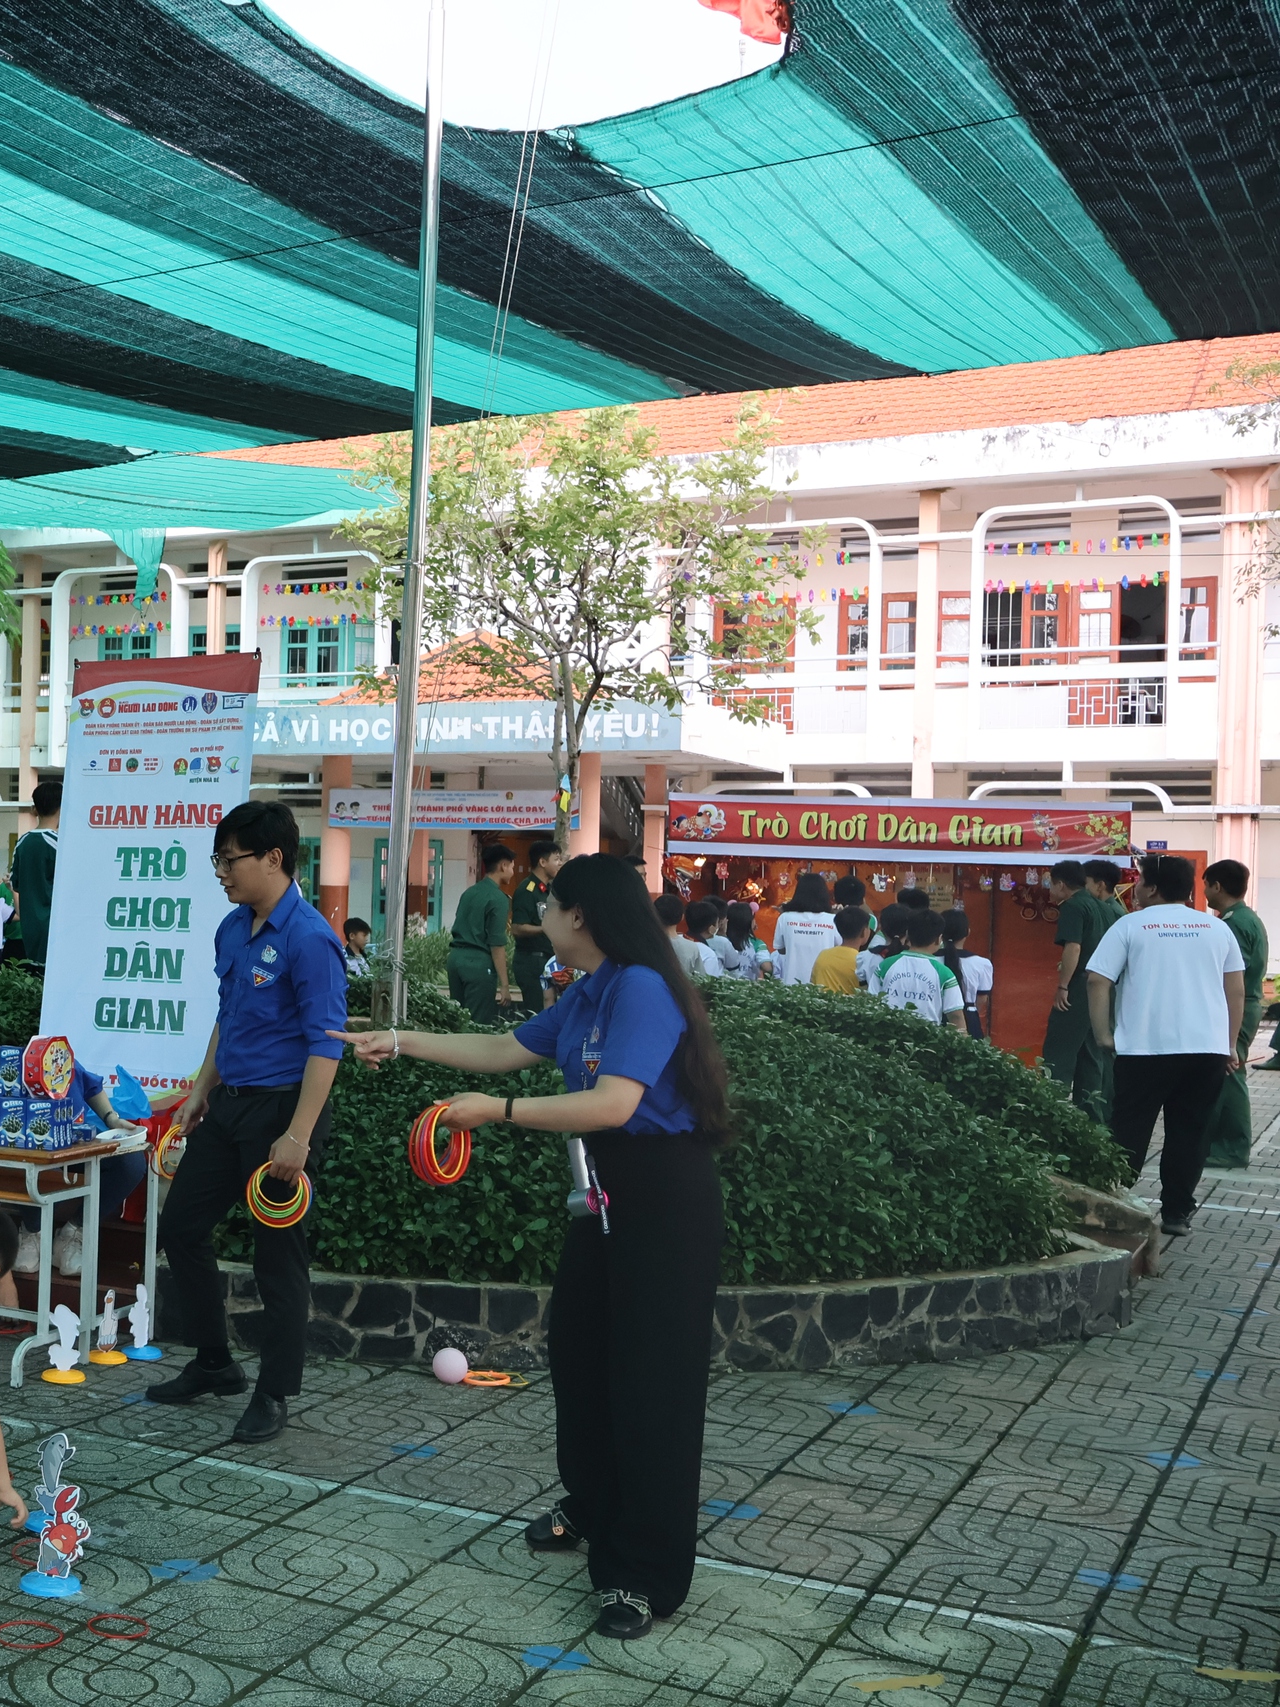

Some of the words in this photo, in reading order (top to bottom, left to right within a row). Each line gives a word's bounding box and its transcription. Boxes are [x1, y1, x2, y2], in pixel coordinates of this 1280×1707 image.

[142, 702, 156, 713] LAO
[291, 714, 319, 742] VÌ
[329, 718, 392, 747] HỌC
[416, 716, 471, 740] INH
[583, 708, 660, 738] YÊU!
[88, 805, 148, 828] GIAN
[153, 800, 222, 828] HÀNG
[446, 803, 463, 813] PHỐ
[737, 809, 789, 838] Trò
[799, 811, 869, 841] Chơi
[877, 813, 938, 843] Dân
[948, 814, 1023, 846] Gian
[114, 839, 187, 881] TRÒ
[105, 896, 192, 932] CHƠI
[102, 940, 185, 984] DÂN
[93, 997, 187, 1036] GIAN
[1, 1049, 20, 1057] OREO
[2, 1100, 24, 1109] OREO
[29, 1102, 52, 1111] OREO
